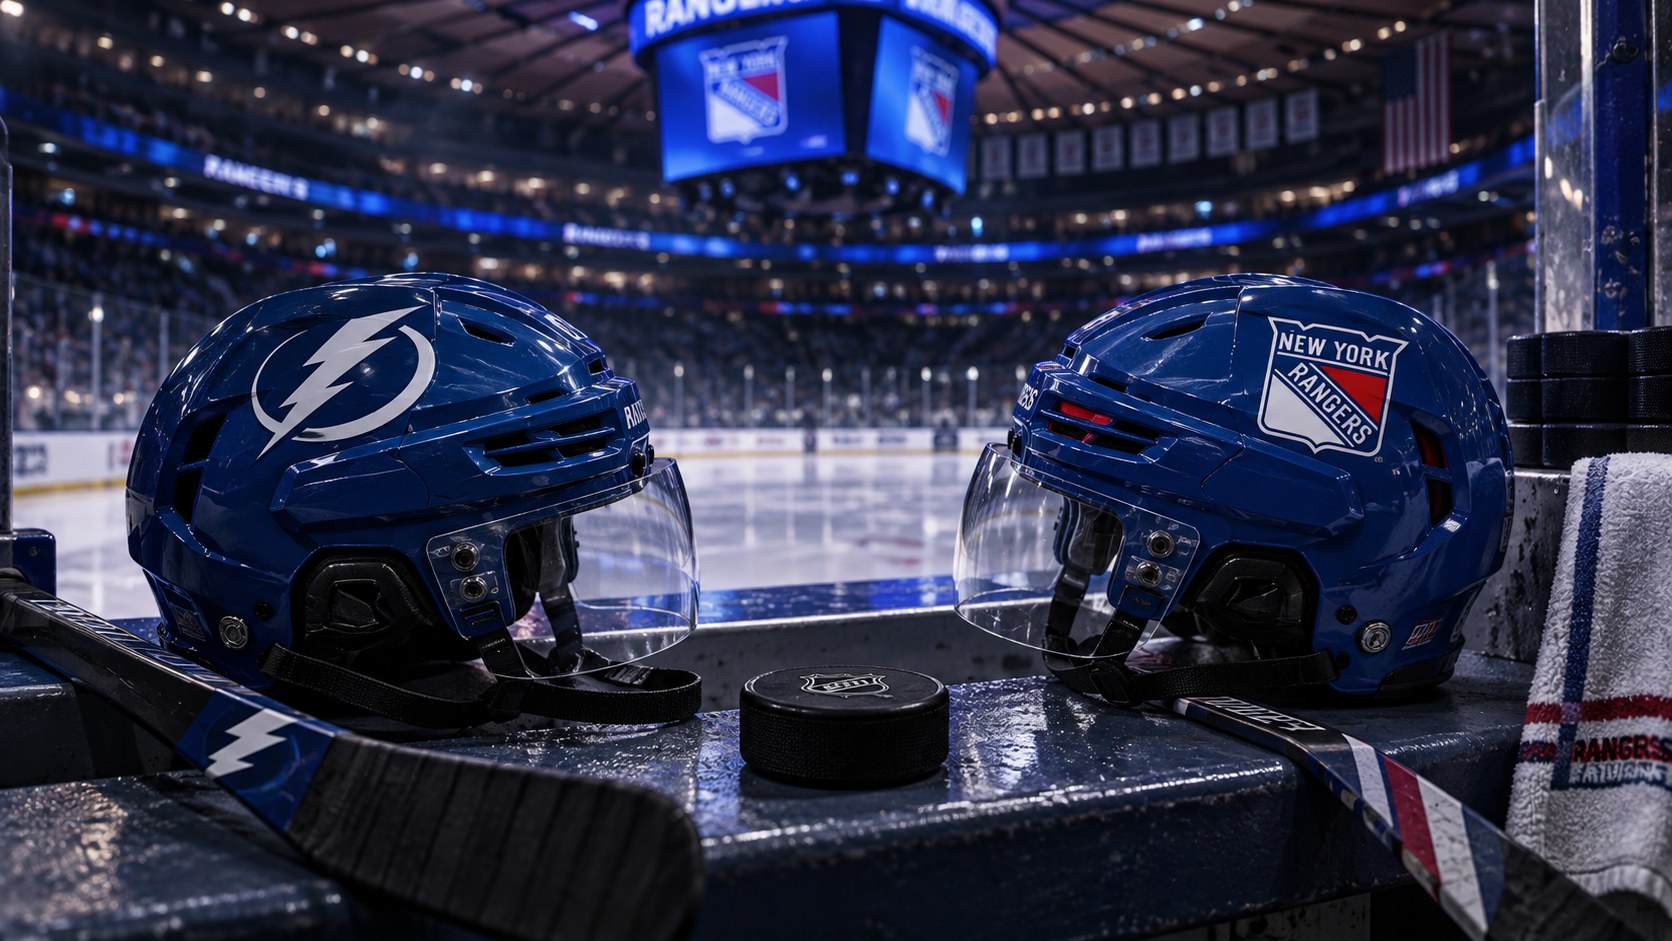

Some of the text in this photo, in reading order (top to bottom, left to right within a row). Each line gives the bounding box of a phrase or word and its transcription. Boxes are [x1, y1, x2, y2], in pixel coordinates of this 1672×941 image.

[1278, 331, 1390, 370] NEW YORK
[1287, 362, 1373, 445] RANGERS
